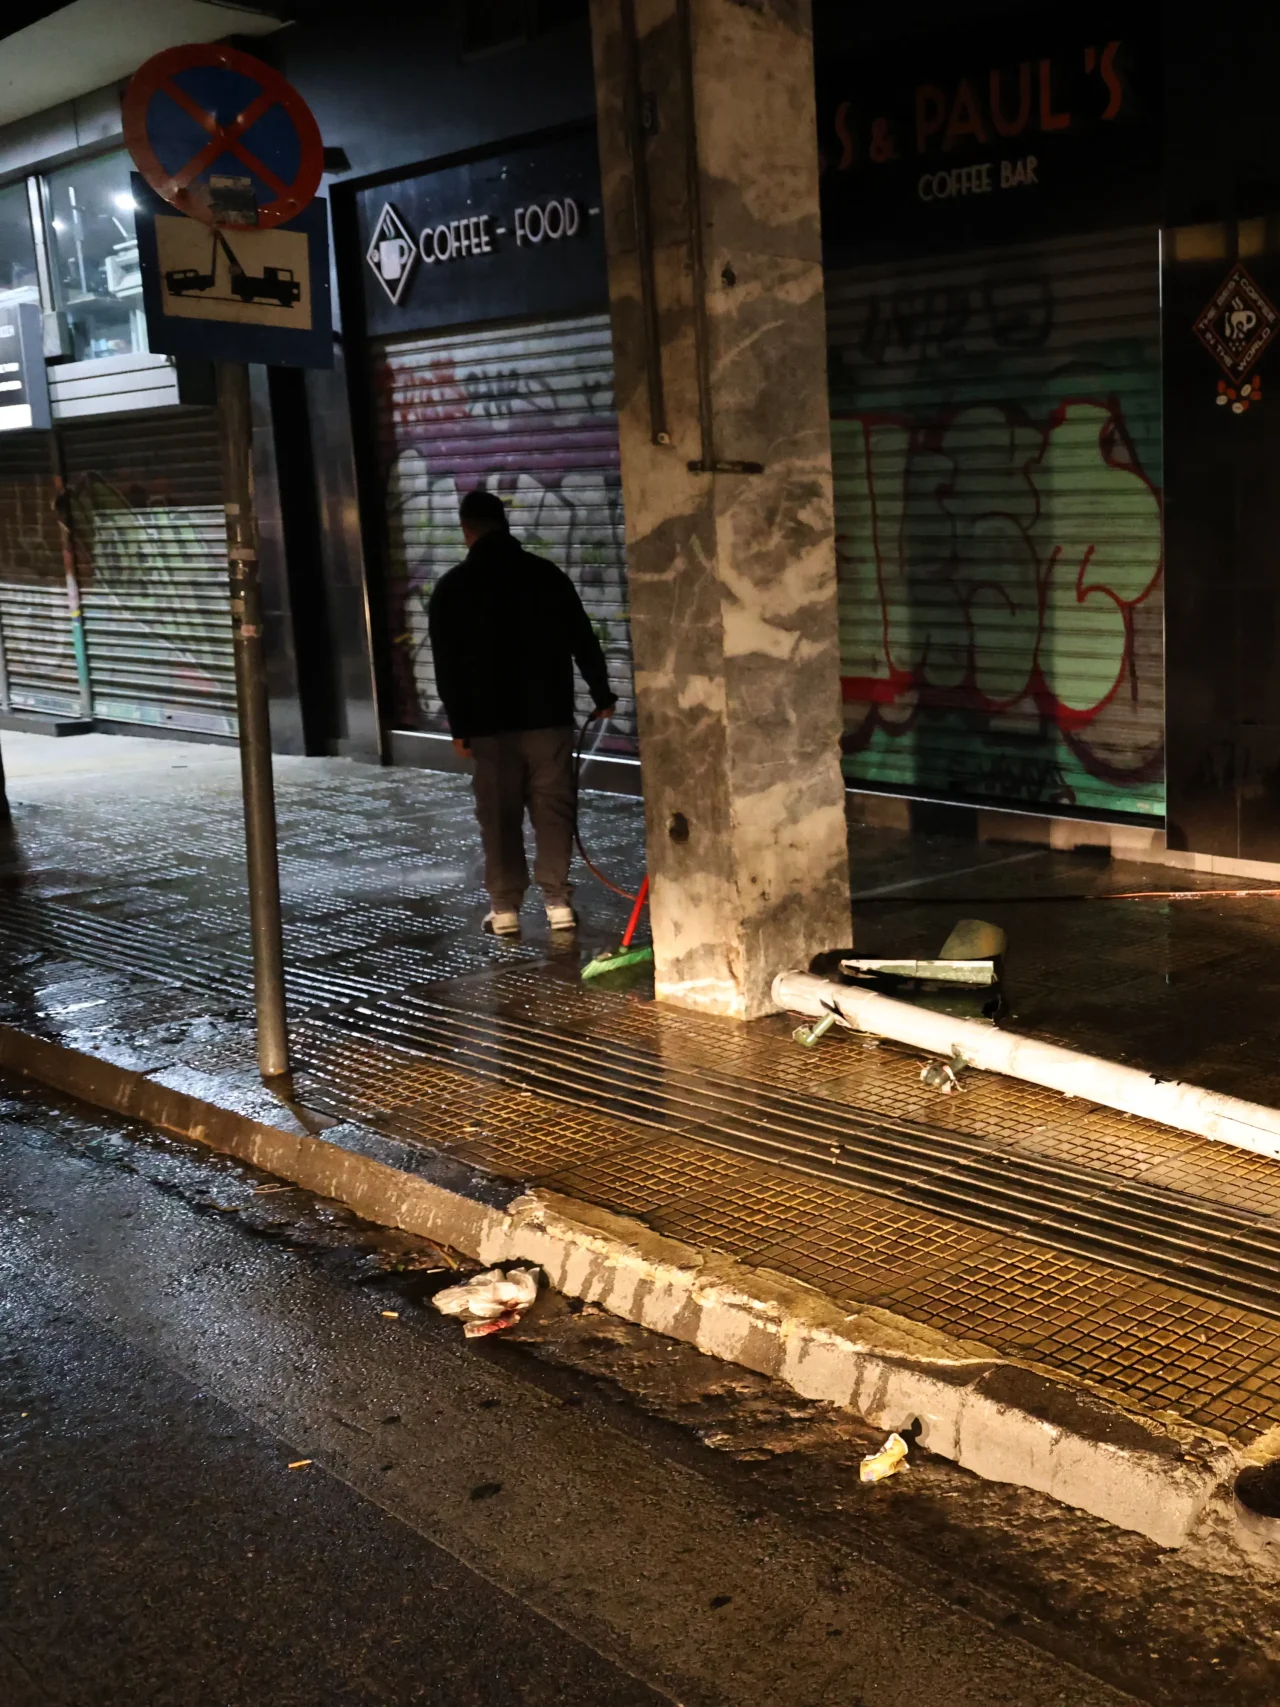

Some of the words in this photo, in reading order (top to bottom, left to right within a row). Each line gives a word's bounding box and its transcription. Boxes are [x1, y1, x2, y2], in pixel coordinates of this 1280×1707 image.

[834, 100, 853, 171] S
[869, 116, 897, 163] &
[917, 161, 993, 202] COFFEE
[1001, 155, 1039, 189] BAR
[419, 213, 492, 263] COFFEE
[515, 197, 580, 246] FOOD
[1240, 278, 1276, 323] COFFEE
[1216, 343, 1234, 367] THE
[1237, 327, 1271, 371] WORLD
